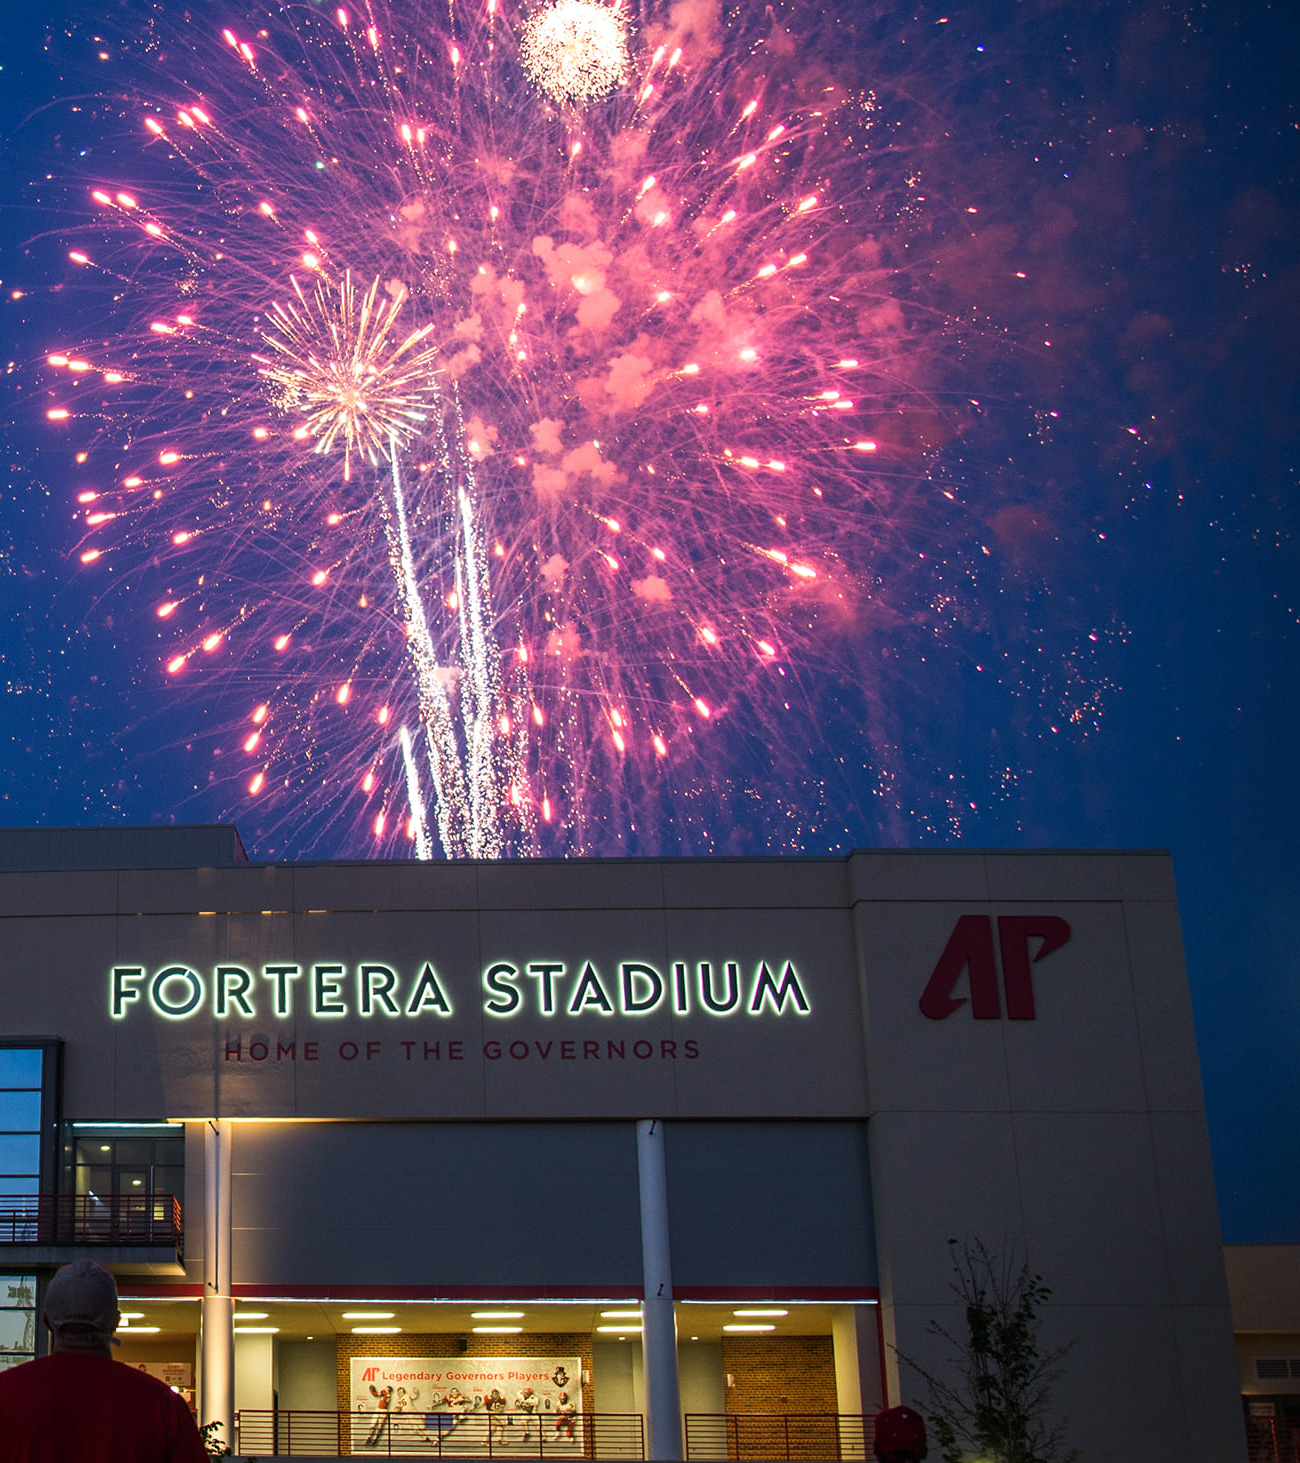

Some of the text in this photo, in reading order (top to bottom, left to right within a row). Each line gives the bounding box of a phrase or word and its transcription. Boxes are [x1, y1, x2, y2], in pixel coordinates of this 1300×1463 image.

[919, 914, 1071, 1020] AP
[111, 959, 811, 1017] FORTERA STADIUM
[225, 1039, 700, 1062] HOME OF THE GOVERNORS
[382, 1371, 442, 1382] Legendary
[445, 1371, 504, 1381] Governors
[507, 1371, 549, 1382] Players
